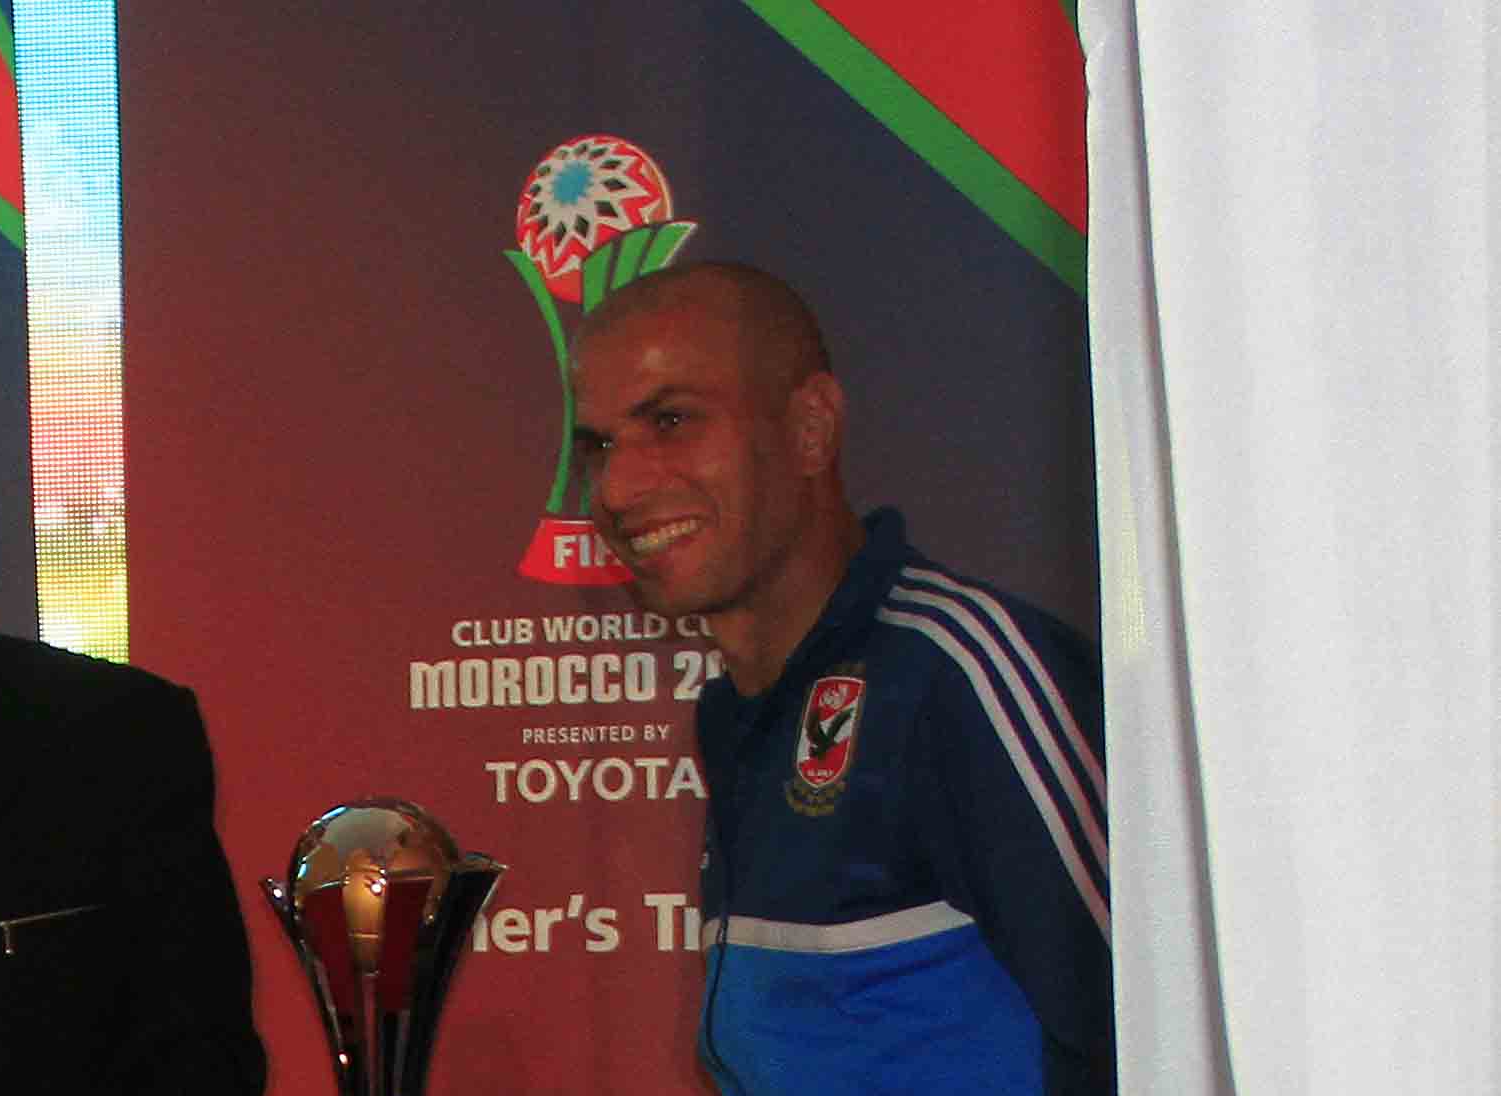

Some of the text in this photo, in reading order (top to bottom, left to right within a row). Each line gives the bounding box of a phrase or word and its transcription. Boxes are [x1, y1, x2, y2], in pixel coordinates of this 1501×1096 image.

[451, 618, 534, 647] CLUB
[542, 612, 668, 643] WORLD
[409, 652, 656, 709] MOROCCO
[522, 725, 670, 744] PRESENTED BY
[484, 756, 706, 803] TOYOTA
